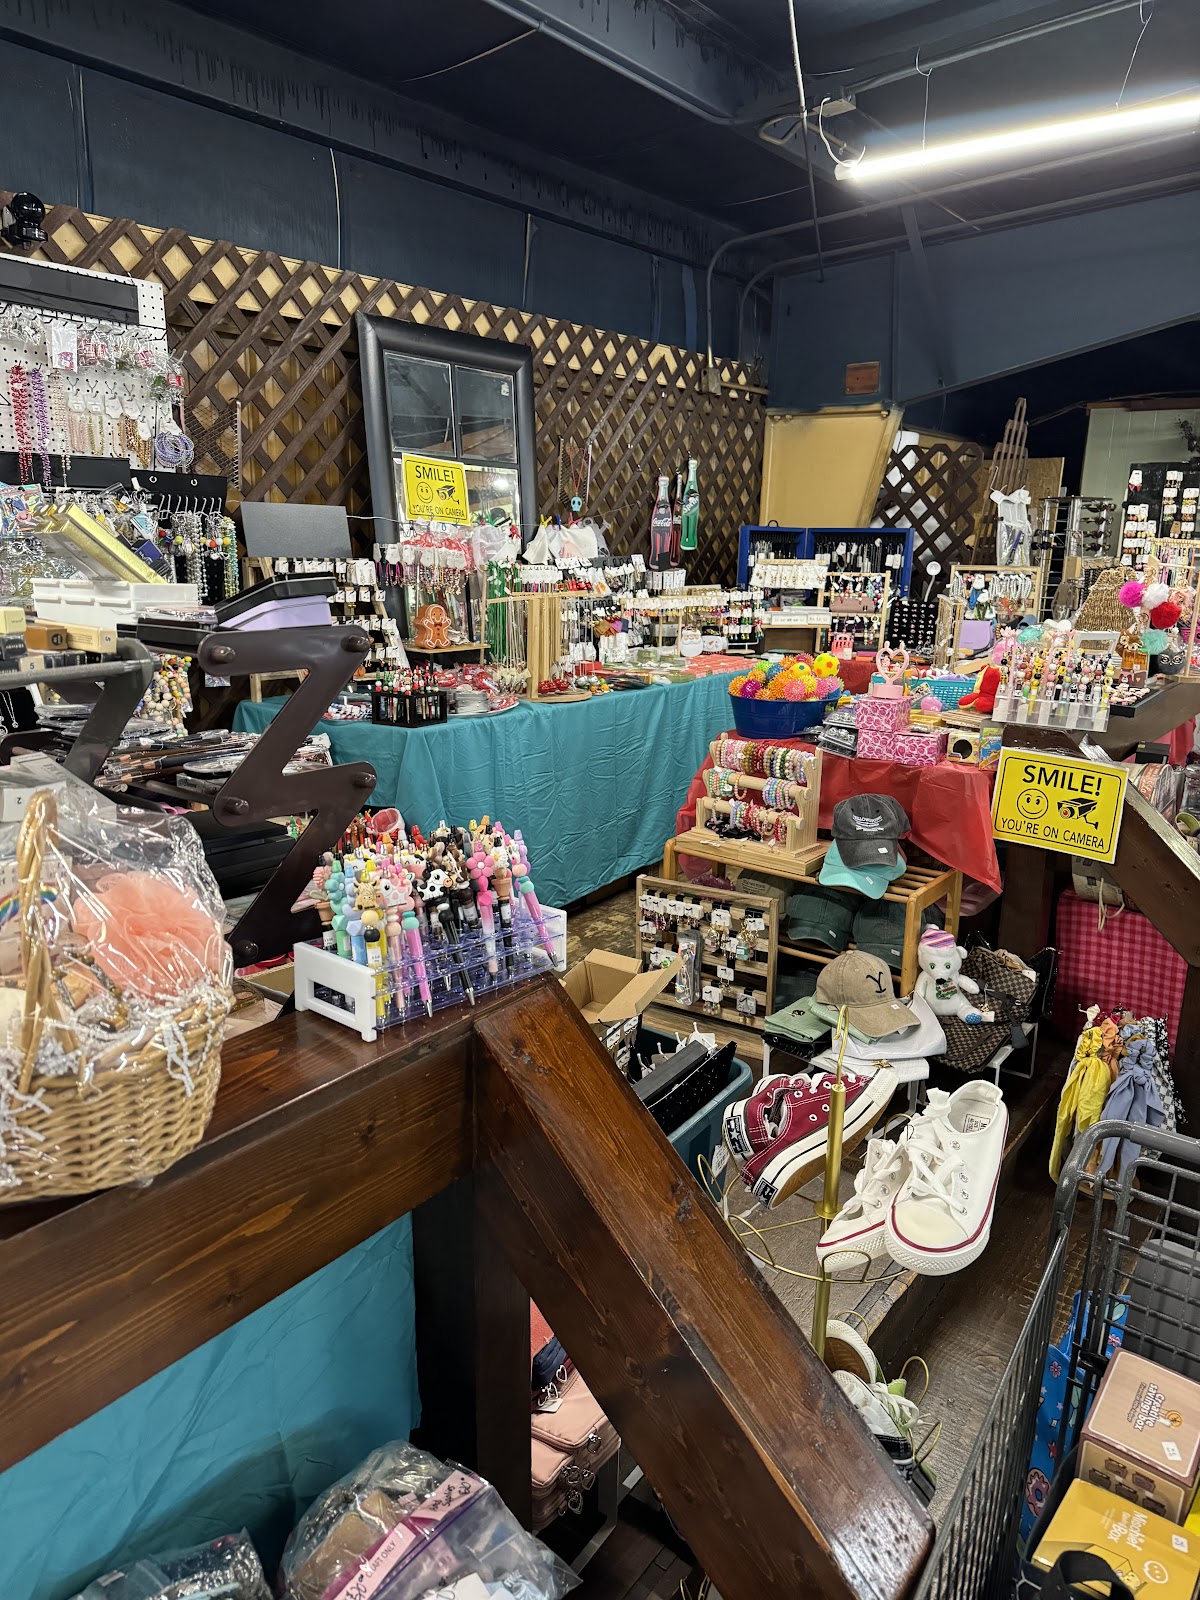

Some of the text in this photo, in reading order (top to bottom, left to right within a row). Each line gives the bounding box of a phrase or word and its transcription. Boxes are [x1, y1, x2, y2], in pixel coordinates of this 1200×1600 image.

[415, 465, 455, 483] SMILE!
[412, 504, 465, 518] YOU'RE ON CAMERA
[29, 662, 35, 670] 5
[1022, 764, 1103, 797] SMILE!
[1001, 817, 1105, 850] YOU'RE ON CAMERA
[1133, 1382, 1158, 1432] savings box
[1145, 1392, 1165, 1427] Creative
[1107, 1523, 1128, 1543] Box
[1126, 1510, 1148, 1551] Mischief
[382, 1541, 397, 1560] ONLY
